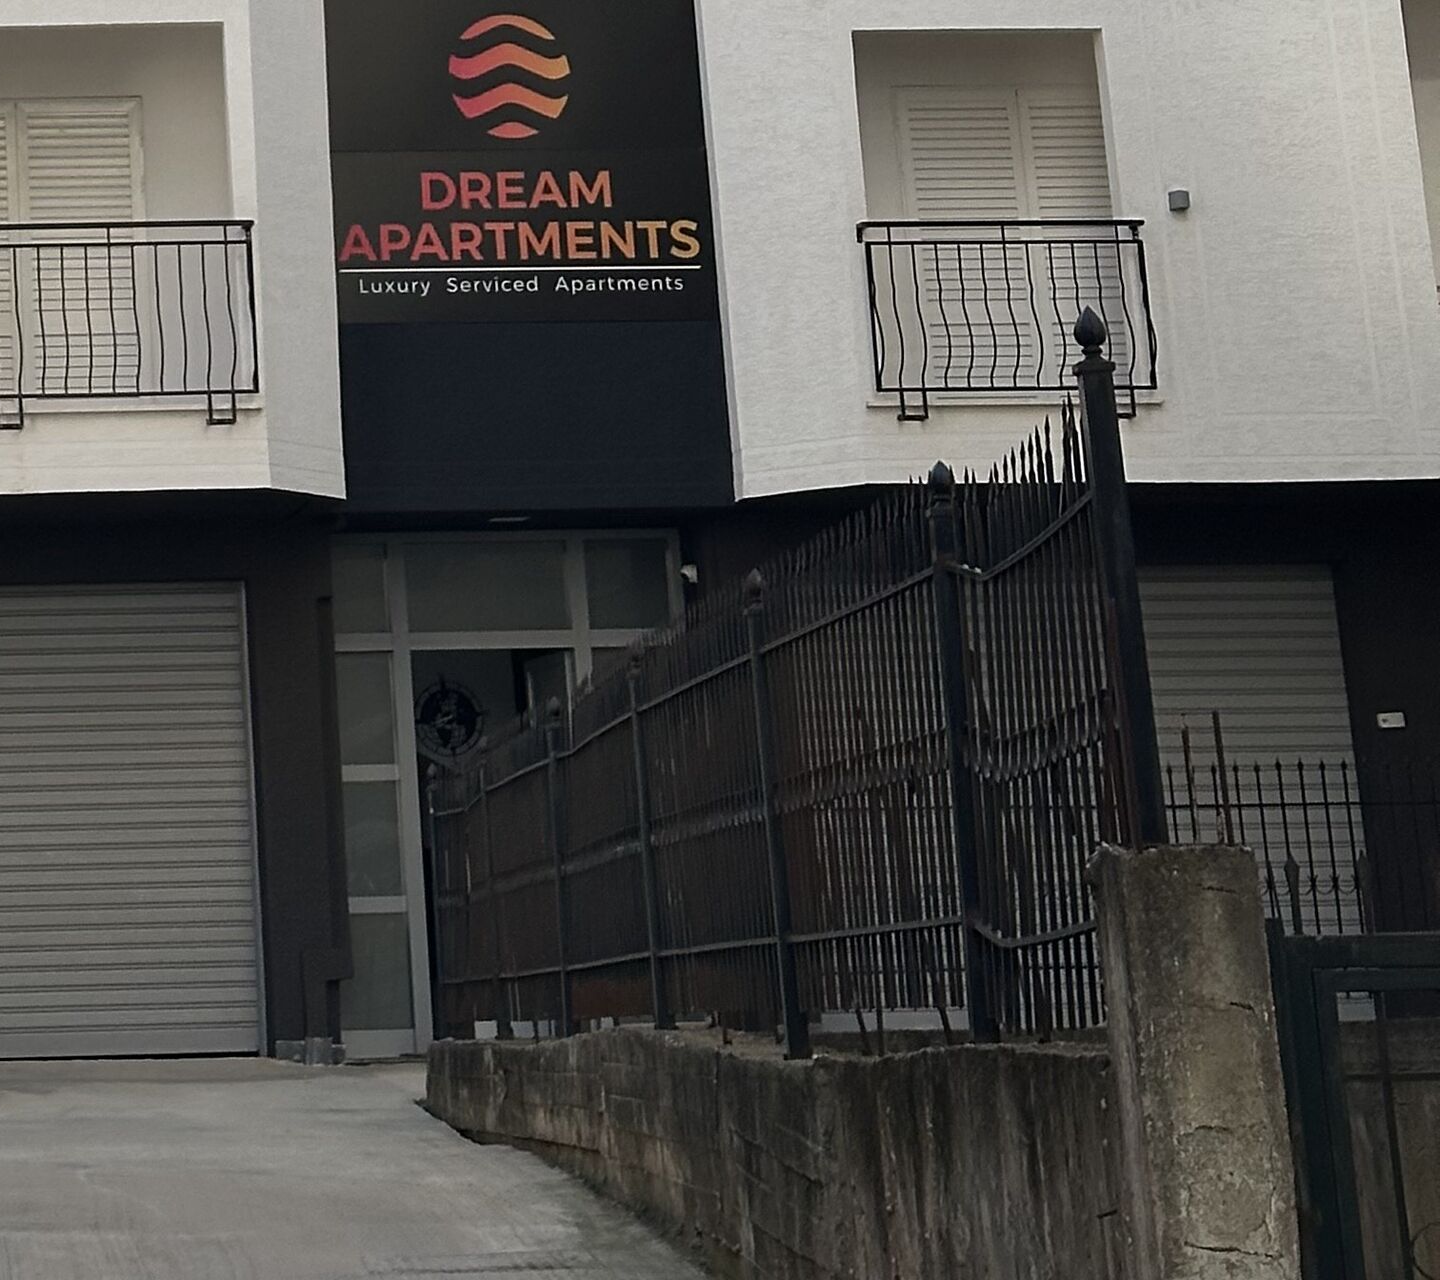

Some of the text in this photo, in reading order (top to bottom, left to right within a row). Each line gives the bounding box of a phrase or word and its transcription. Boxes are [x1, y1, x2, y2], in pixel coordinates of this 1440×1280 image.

[421, 170, 613, 210] DREAM
[339, 219, 701, 261] APARTMENTS
[359, 275, 684, 297] Luxury Serviced Apartments
